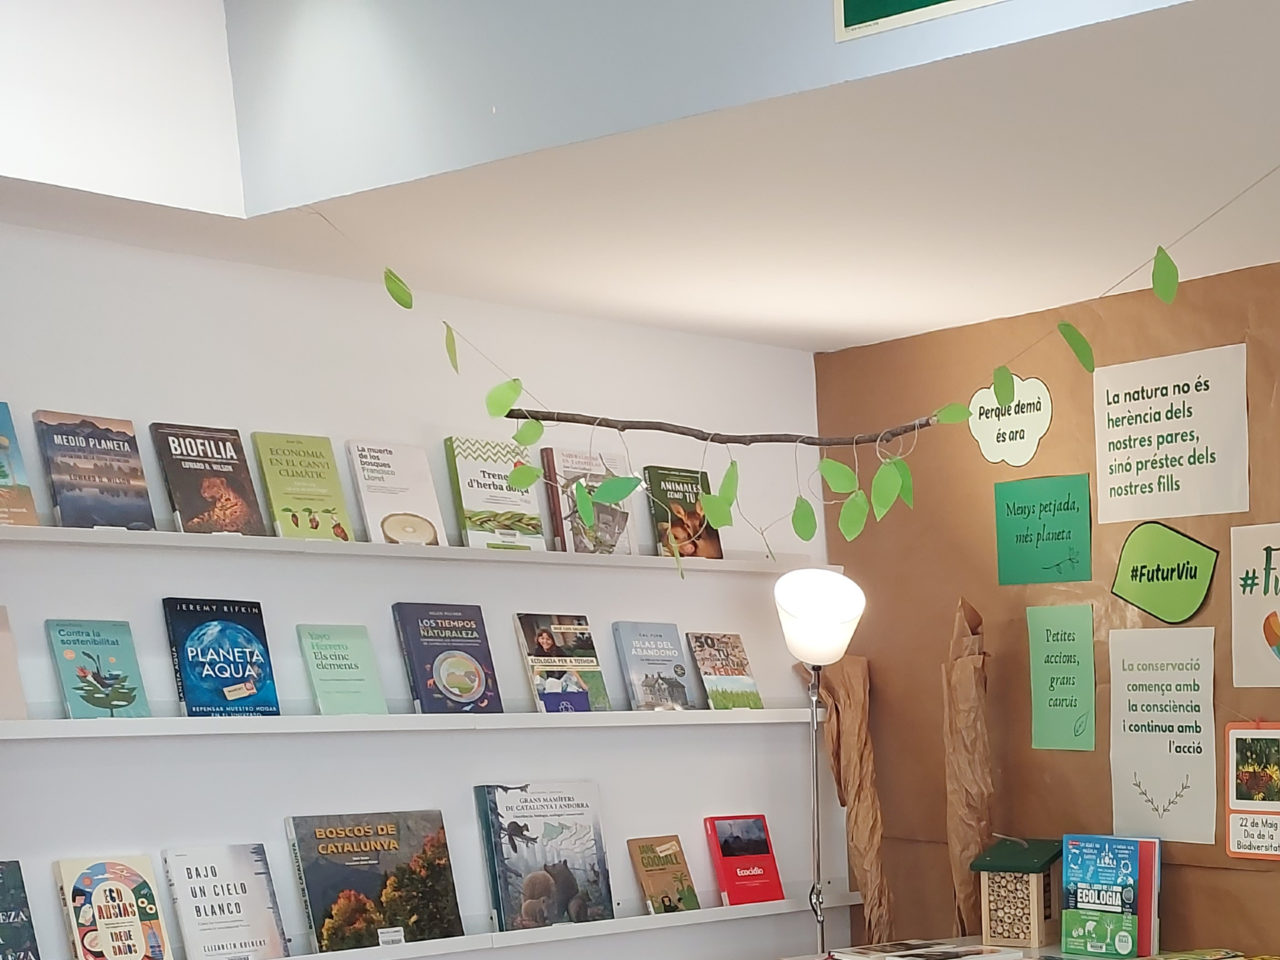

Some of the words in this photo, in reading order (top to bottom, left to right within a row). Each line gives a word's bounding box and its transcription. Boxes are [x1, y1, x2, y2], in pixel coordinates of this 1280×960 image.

[1106, 389, 1120, 406] La
[1124, 385, 1169, 404] natura
[1172, 381, 1190, 395] no
[1194, 375, 1210, 392] és
[1014, 397, 1042, 416] demà
[1107, 406, 1162, 429] herència
[1165, 401, 1193, 420] dels
[996, 428, 1006, 443] és
[1008, 429, 1025, 442] ara
[1108, 433, 1153, 452] nostres
[1156, 429, 1200, 449] pares,
[54, 434, 86, 447] MEDIO
[89, 438, 131, 452] PLANETA
[168, 436, 237, 459] BIOFILIA
[367, 447, 393, 455] muerte
[270, 458, 283, 466] EN
[299, 461, 330, 469] CANVI
[360, 460, 391, 468] bosques
[1109, 455, 1132, 476] sinó
[1136, 451, 1184, 475] préstec
[1187, 447, 1216, 466] dels
[362, 467, 395, 475] Francisco
[480, 470, 508, 481] Trene
[468, 479, 504, 492] d'herba
[661, 481, 701, 492] ANIMALES
[1109, 478, 1154, 498] nostres
[1157, 475, 1180, 493] fills
[1006, 502, 1036, 519] Menys
[1038, 492, 1080, 520] petjada,
[1016, 525, 1033, 544] més
[1036, 525, 1071, 548] planeta
[1130, 561, 1198, 583] #FuturViu
[177, 604, 216, 612] JEREMY
[224, 606, 259, 614] RIFKIN
[419, 619, 436, 627] LOS
[437, 619, 476, 628] TIEMPOS
[58, 629, 90, 637] Contra
[420, 629, 479, 638] NATURALEZA
[1046, 629, 1076, 643] Petites
[694, 636, 716, 648] 50
[188, 647, 264, 663] PLANETA
[314, 652, 328, 660] Els
[330, 652, 349, 660] cinc
[632, 648, 678, 657] ABANDONO
[1044, 652, 1080, 666] accions,
[202, 663, 257, 678] AQUA
[316, 661, 359, 670] elements
[1122, 660, 1134, 672] La
[1137, 659, 1201, 672] conservació
[1049, 675, 1076, 691] grans
[1127, 682, 1172, 695] comença
[1175, 679, 1200, 692] amb
[1048, 697, 1078, 708] canvis
[1128, 699, 1138, 712] la
[1141, 699, 1200, 713] consciència
[1123, 720, 1126, 732] i
[1129, 721, 1174, 733] continua
[1177, 720, 1202, 733] amb
[1169, 740, 1203, 754] l'acció
[1239, 817, 1249, 827] 22
[1250, 817, 1259, 827] de
[1261, 820, 1278, 831] Maig
[315, 826, 374, 839] BOSCOS
[376, 824, 397, 835] DE
[1244, 831, 1256, 839] Dia
[1257, 831, 1266, 839] de
[1268, 831, 1273, 840] la
[318, 840, 399, 855] CATALUNYA
[1237, 840, 1280, 852] Biodiversitat
[641, 854, 681, 868] GOODALL
[186, 866, 218, 879] BAJO
[190, 886, 207, 898] UN
[213, 882, 247, 896] CIELO
[195, 902, 242, 917] BLANCO
